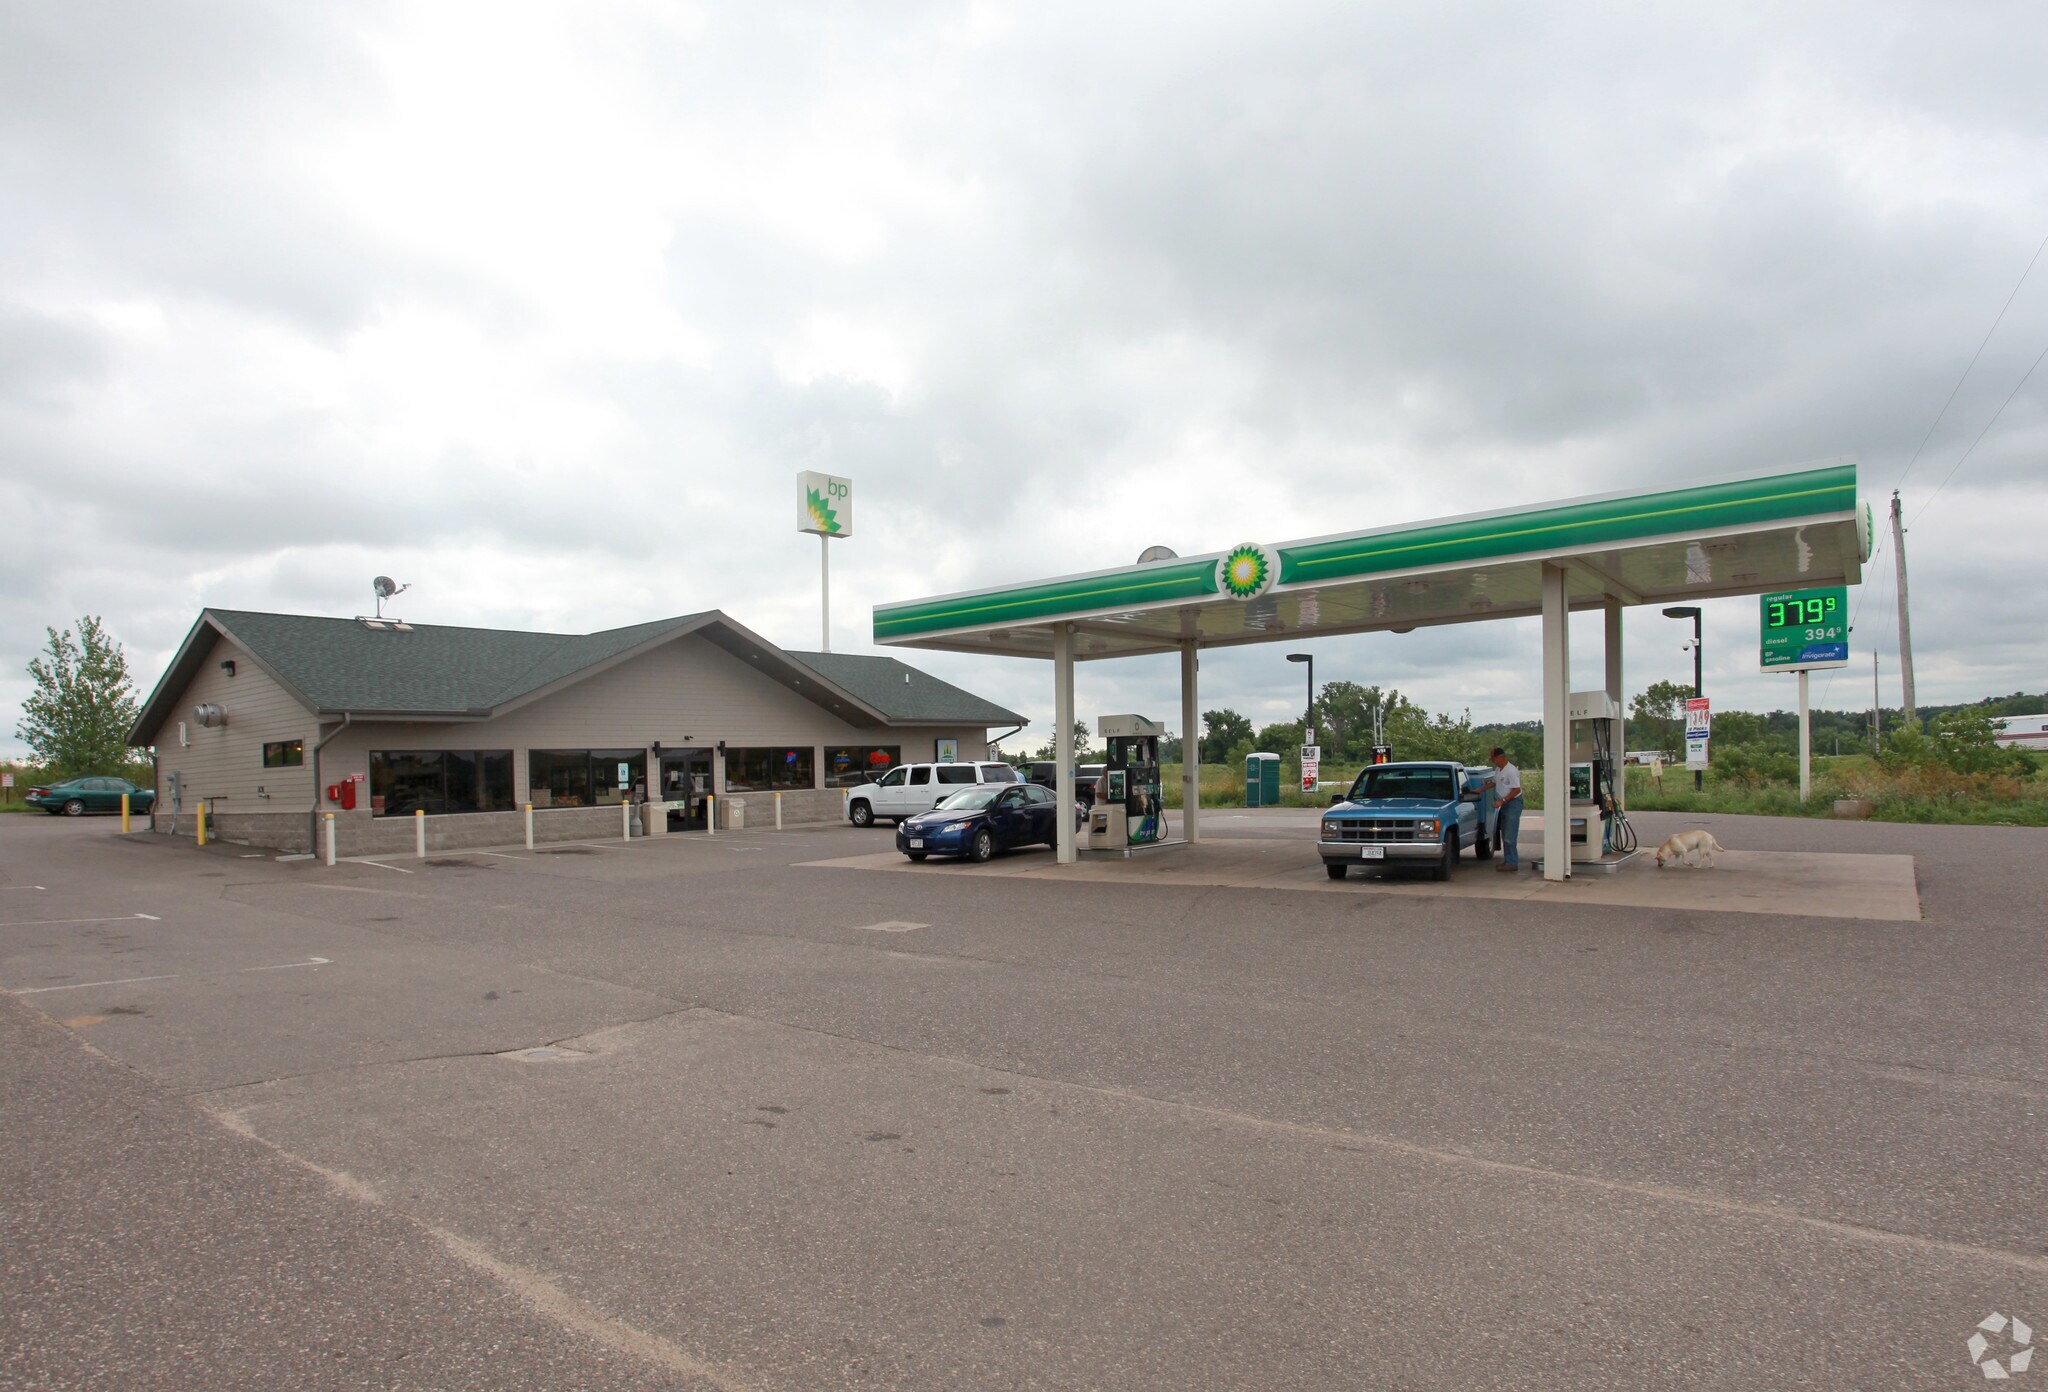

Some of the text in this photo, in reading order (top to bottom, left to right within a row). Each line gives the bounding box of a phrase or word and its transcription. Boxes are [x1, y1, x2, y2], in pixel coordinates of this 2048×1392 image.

[828, 478, 848, 501] bp
[1766, 594, 1793, 602] regular
[1765, 637, 1788, 645] diesel
[1764, 655, 1791, 663] gasoline
